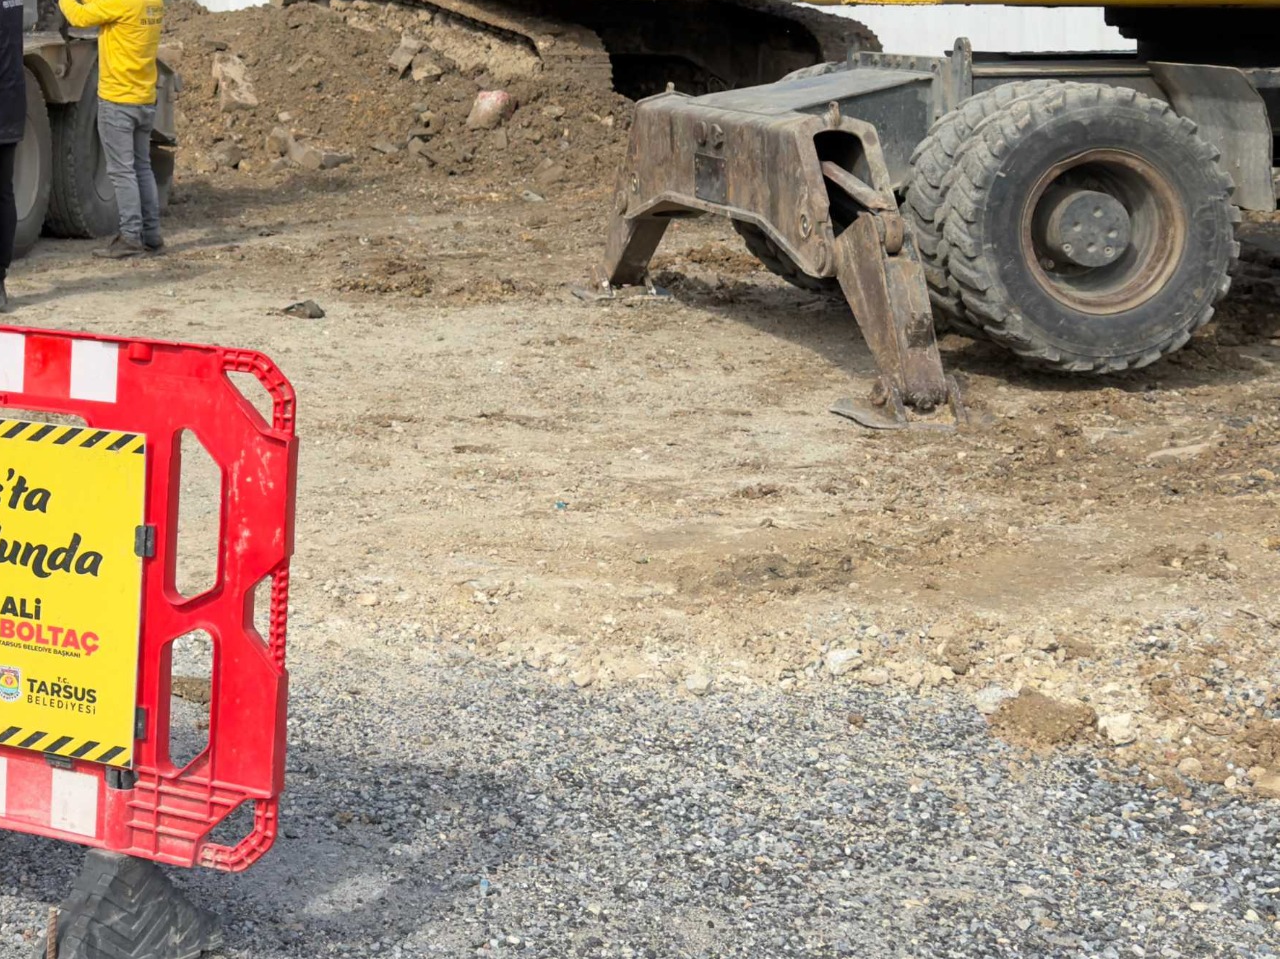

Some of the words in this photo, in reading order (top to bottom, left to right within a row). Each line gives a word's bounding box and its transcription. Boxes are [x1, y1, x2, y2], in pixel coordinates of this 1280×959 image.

[0, 617, 100, 657] BOLTAÇ
[22, 643, 52, 654] BELEDİYE
[53, 648, 81, 658] BAŞKANI
[26, 678, 97, 704] TARSUS
[57, 676, 70, 685] T.C.
[27, 694, 96, 715] BELEDİYESİ
